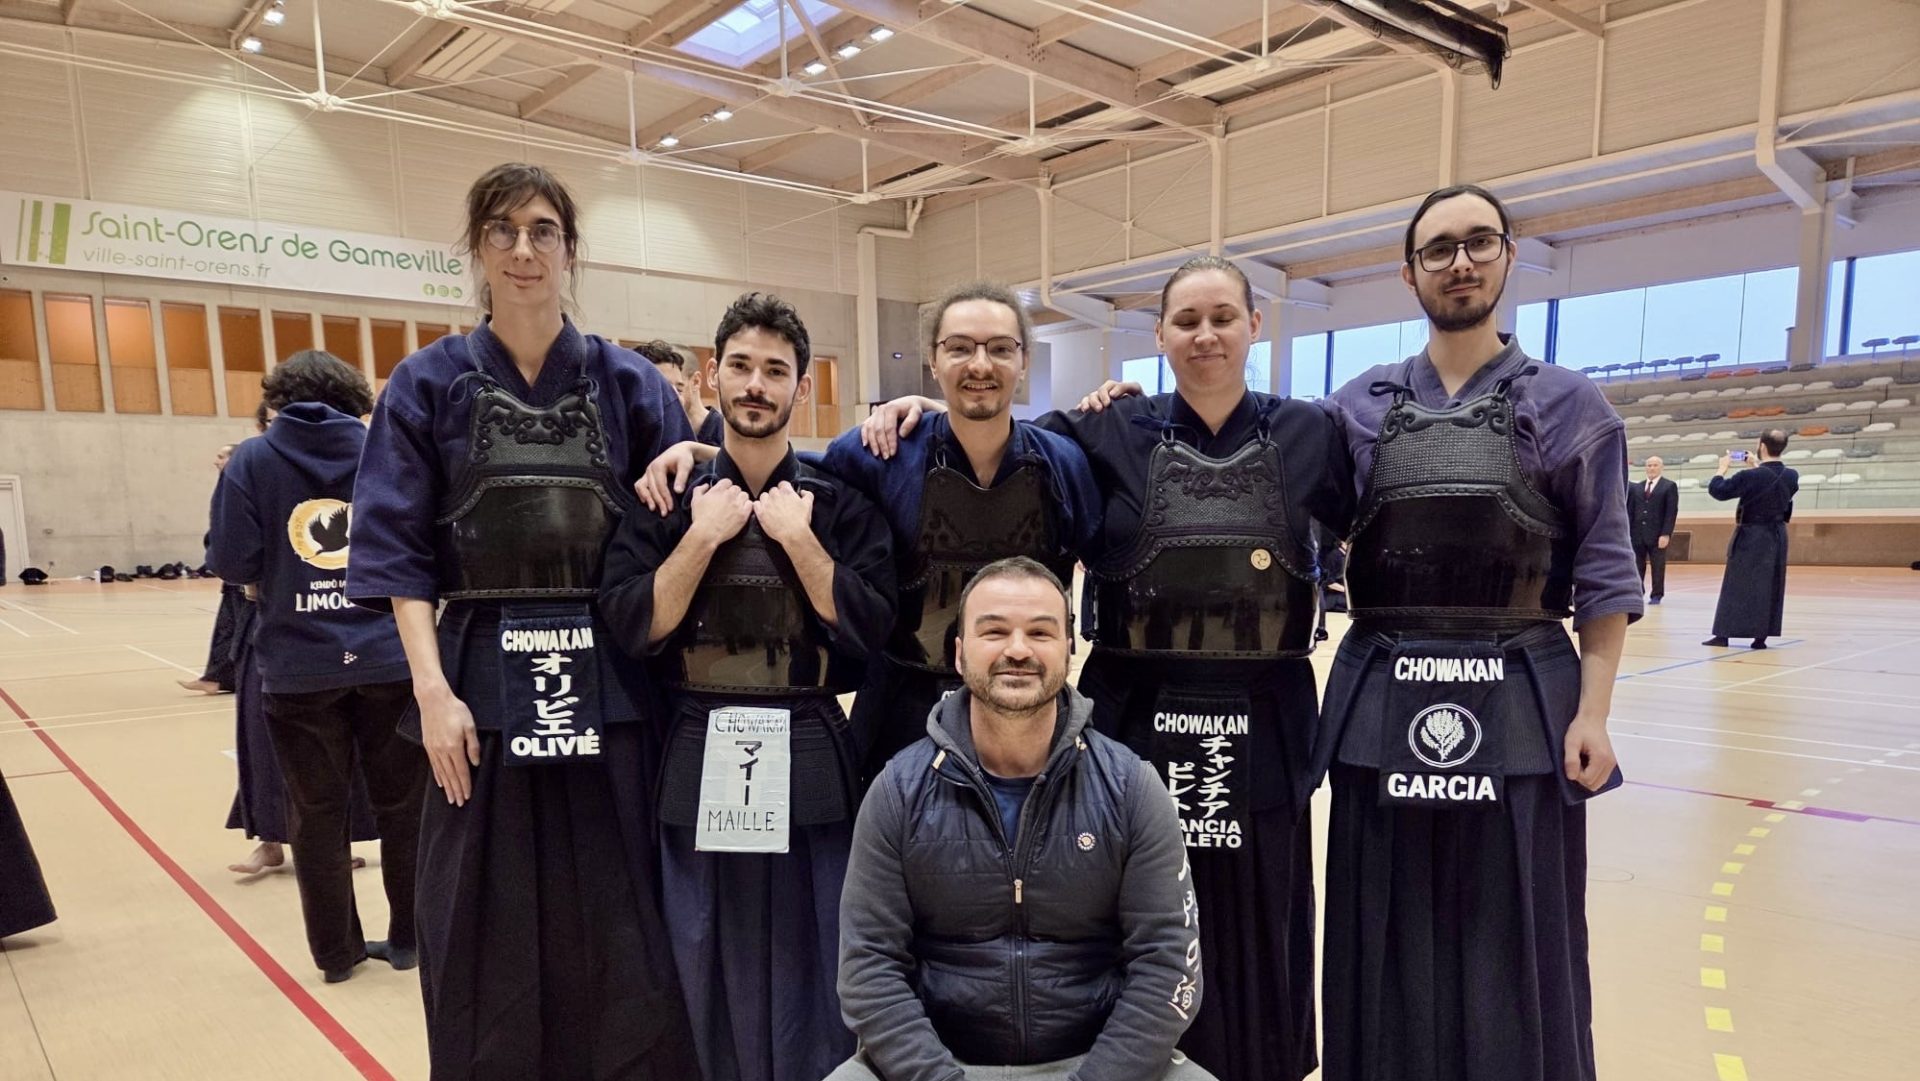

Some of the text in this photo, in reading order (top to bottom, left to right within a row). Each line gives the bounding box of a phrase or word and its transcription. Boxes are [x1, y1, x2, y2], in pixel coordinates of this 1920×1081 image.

[81, 211, 463, 276] Saint-Orens de Gameville
[82, 248, 272, 280] ville-saint-orens.fr
[501, 627, 594, 652] CHOWAKAN
[1394, 656, 1504, 682] CHOWAKAN
[530, 652, 580, 736] オリビエ
[1153, 712, 1249, 735] CHOWAKAN
[510, 727, 600, 757] OLIVIÉ
[1197, 735, 1236, 819] チャンチア
[1387, 773, 1497, 801] GARCIA
[707, 810, 775, 832] MAILLE
